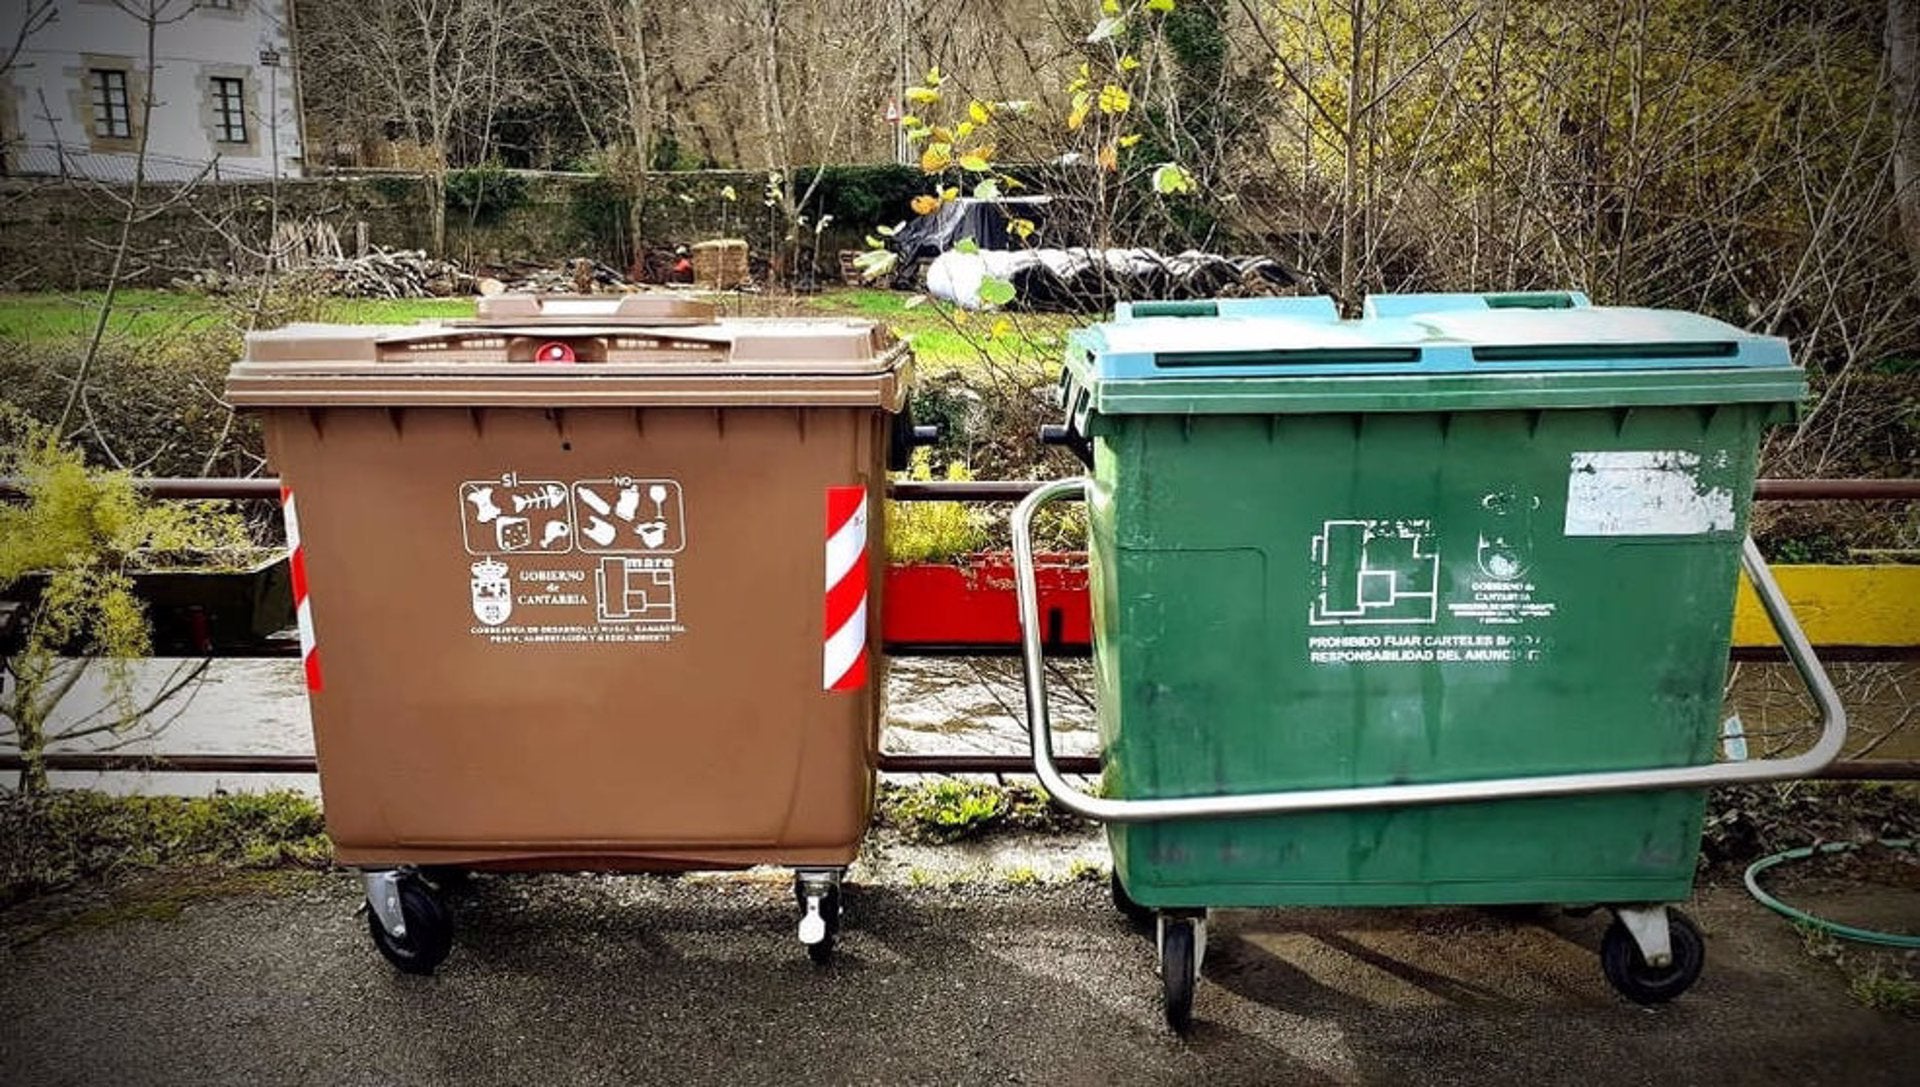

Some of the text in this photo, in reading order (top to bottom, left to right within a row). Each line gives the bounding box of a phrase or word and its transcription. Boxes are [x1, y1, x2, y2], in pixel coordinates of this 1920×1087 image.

[613, 475, 632, 487] NO
[519, 570, 586, 581] GOBIERNO
[546, 582, 560, 592] de
[517, 594, 588, 605] CANTABRIA
[1309, 636, 1381, 649] PROHIBIDO
[1424, 635, 1494, 647] CARTELES
[1310, 650, 1434, 663] RESPONSABILIDAD
[1436, 650, 1461, 661] DEL
